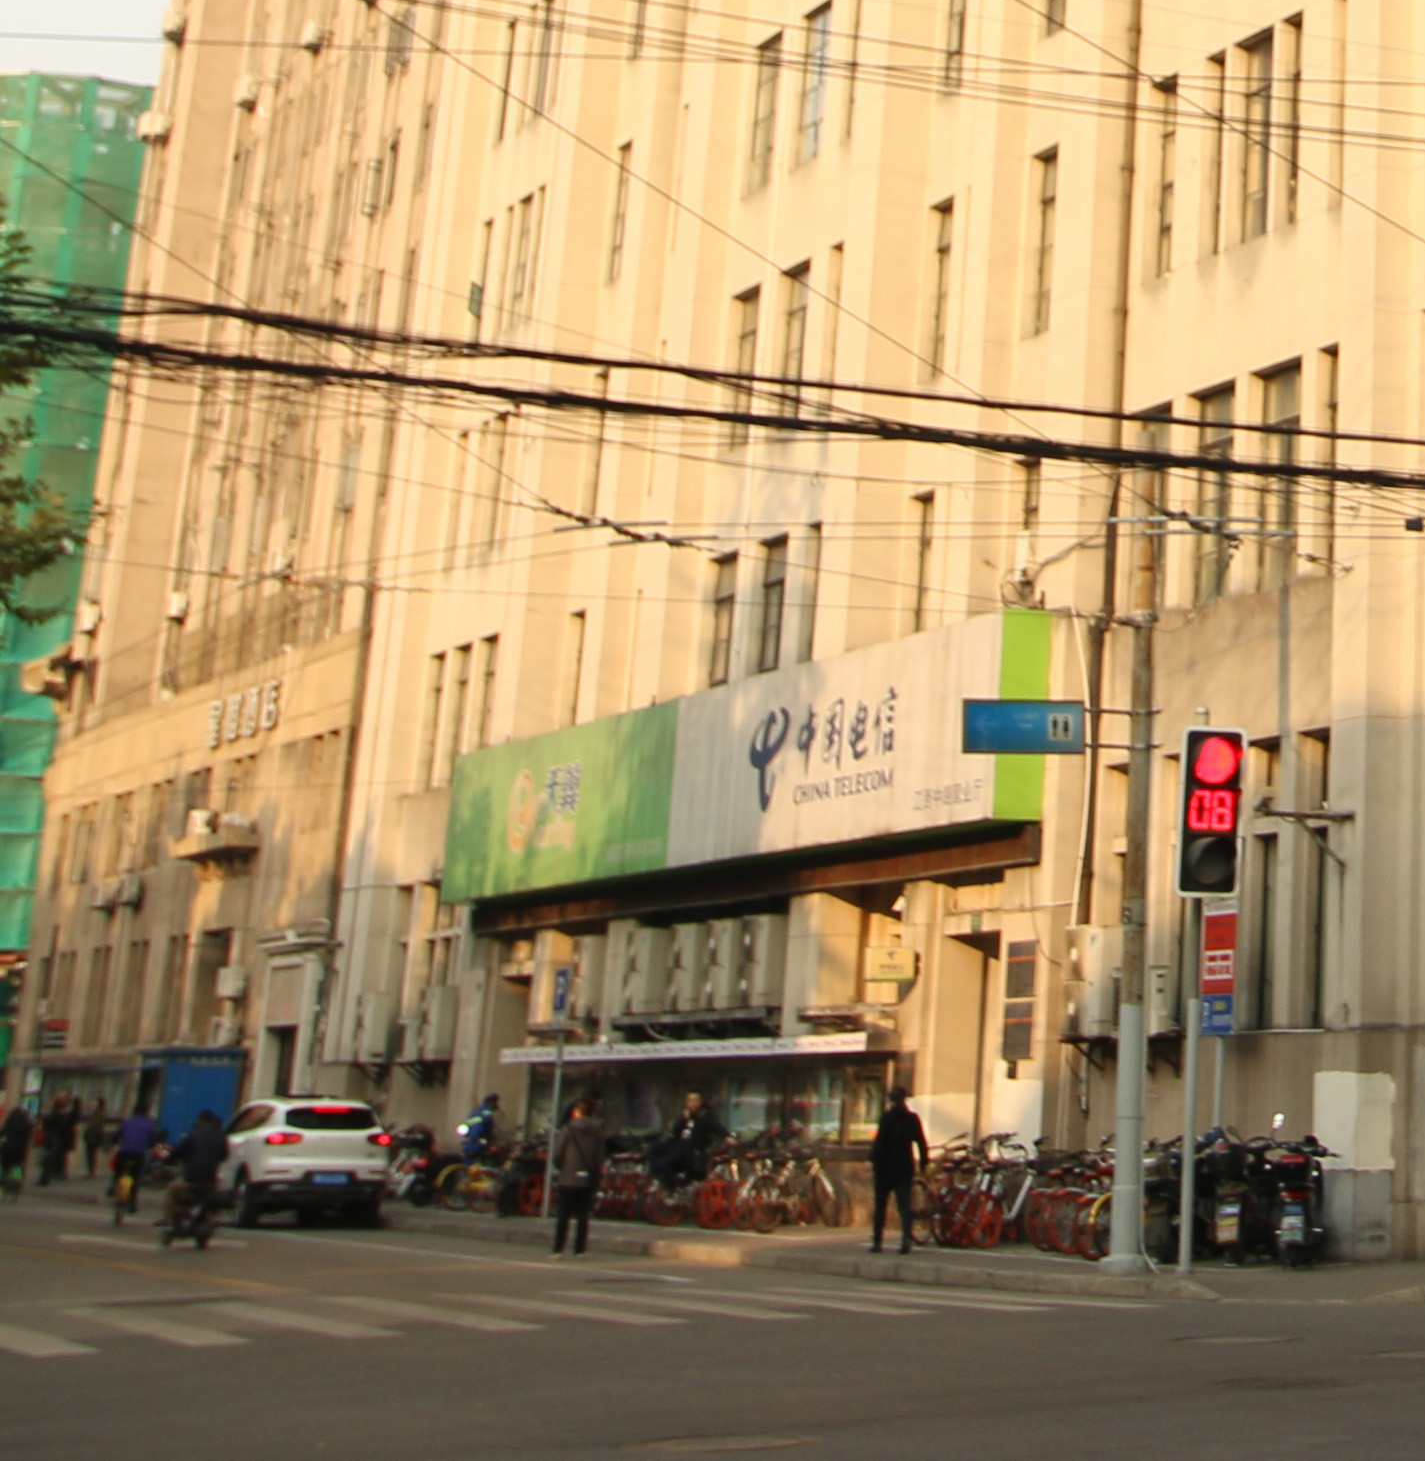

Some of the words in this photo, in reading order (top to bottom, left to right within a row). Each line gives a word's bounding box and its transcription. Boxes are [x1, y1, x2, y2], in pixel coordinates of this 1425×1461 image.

[797, 685, 897, 778] 中国电信
[545, 760, 582, 814] 天翼
[792, 780, 831, 806] CHINA
[834, 767, 893, 797] TELECOM
[1189, 789, 1234, 831] 08
